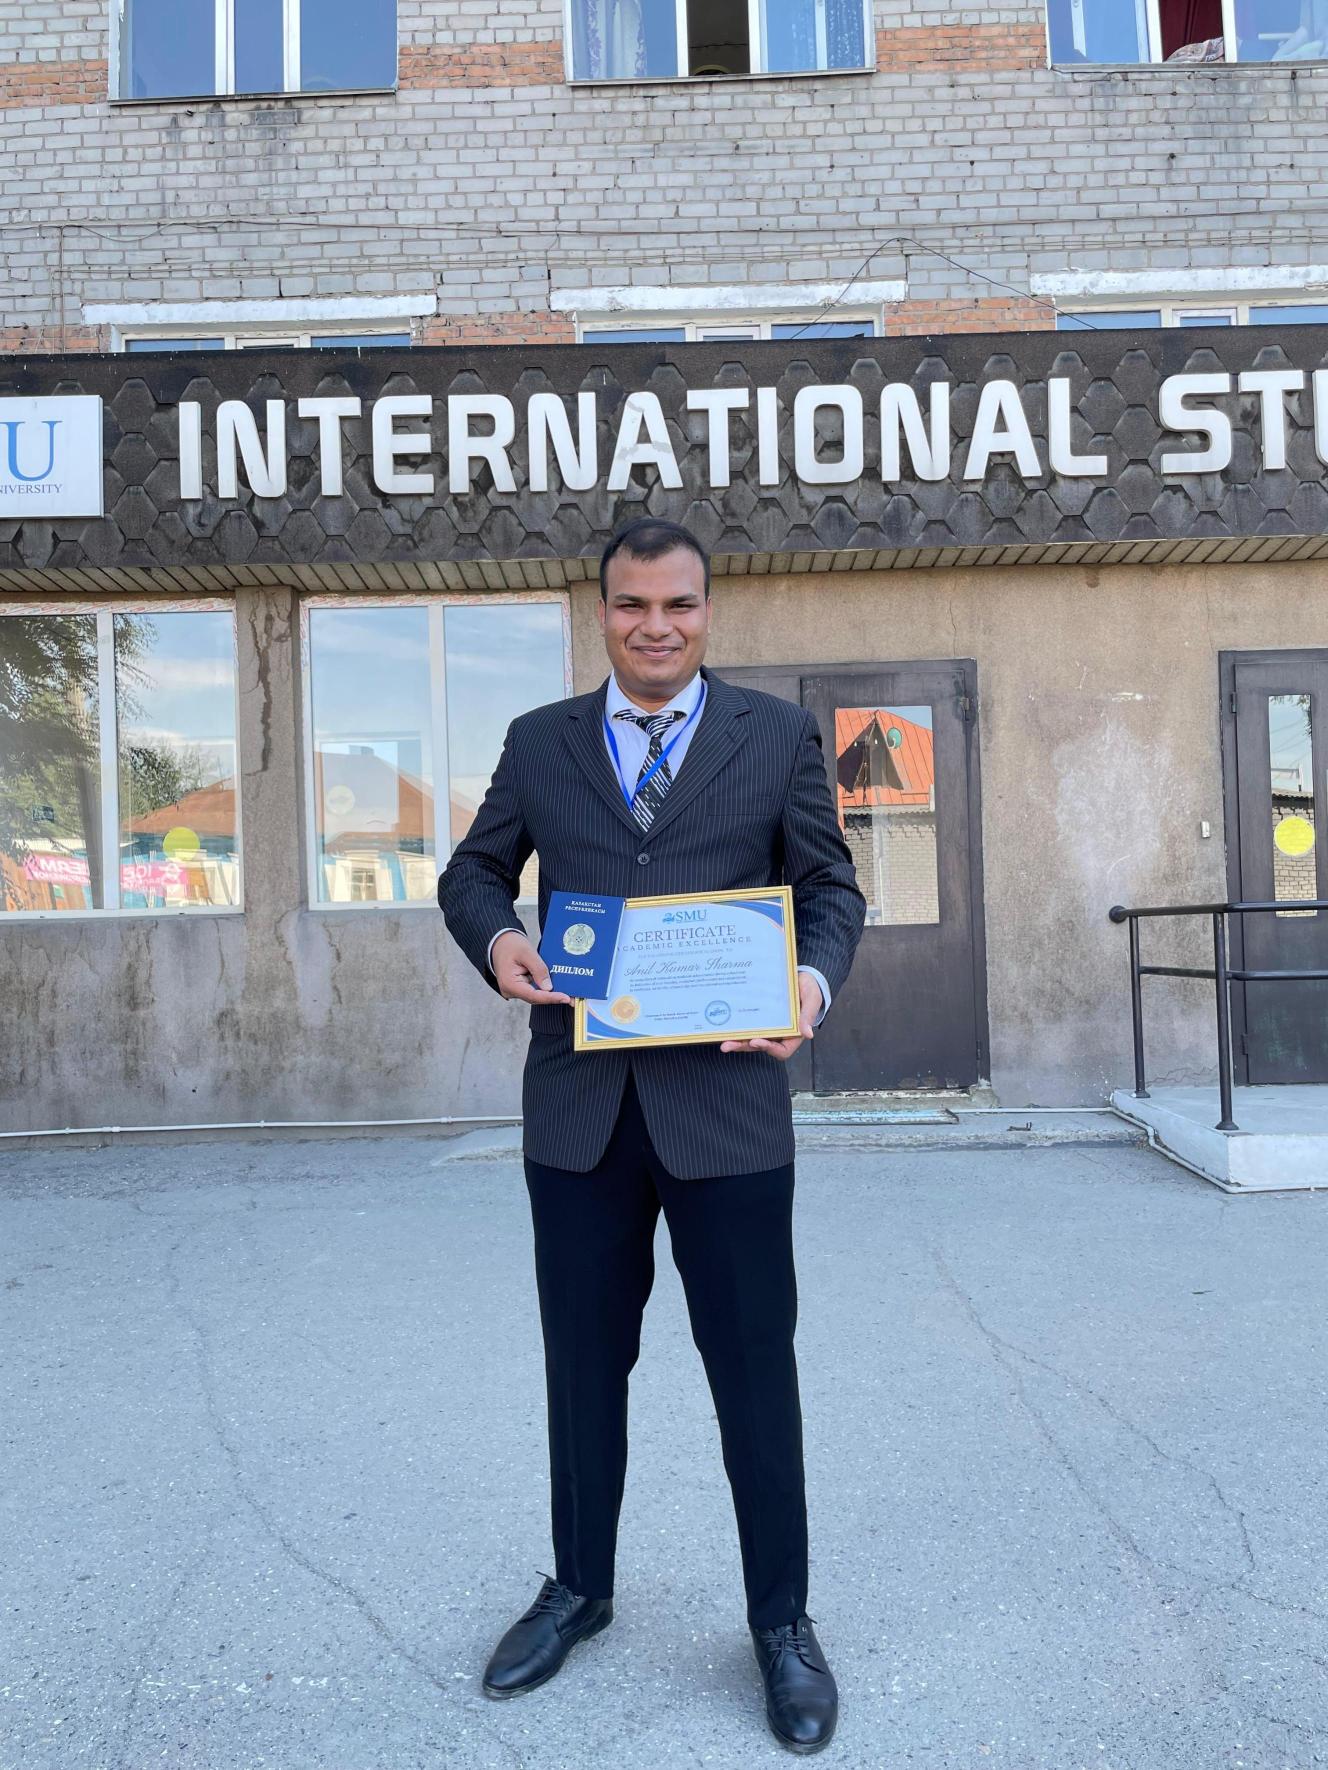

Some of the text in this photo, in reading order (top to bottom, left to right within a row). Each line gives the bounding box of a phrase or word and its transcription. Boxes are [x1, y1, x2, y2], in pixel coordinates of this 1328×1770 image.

[178, 369, 1328, 499] INTERNATIONAL ST
[0, 484, 63, 495] IVERSITY
[676, 909, 707, 922] SMU
[633, 924, 737, 943] CERTIFICATE
[679, 936, 752, 948] EXCELLENCE
[550, 964, 594, 976] ДИПЛОМ
[624, 957, 753, 976] Anil Kumar Sharma
